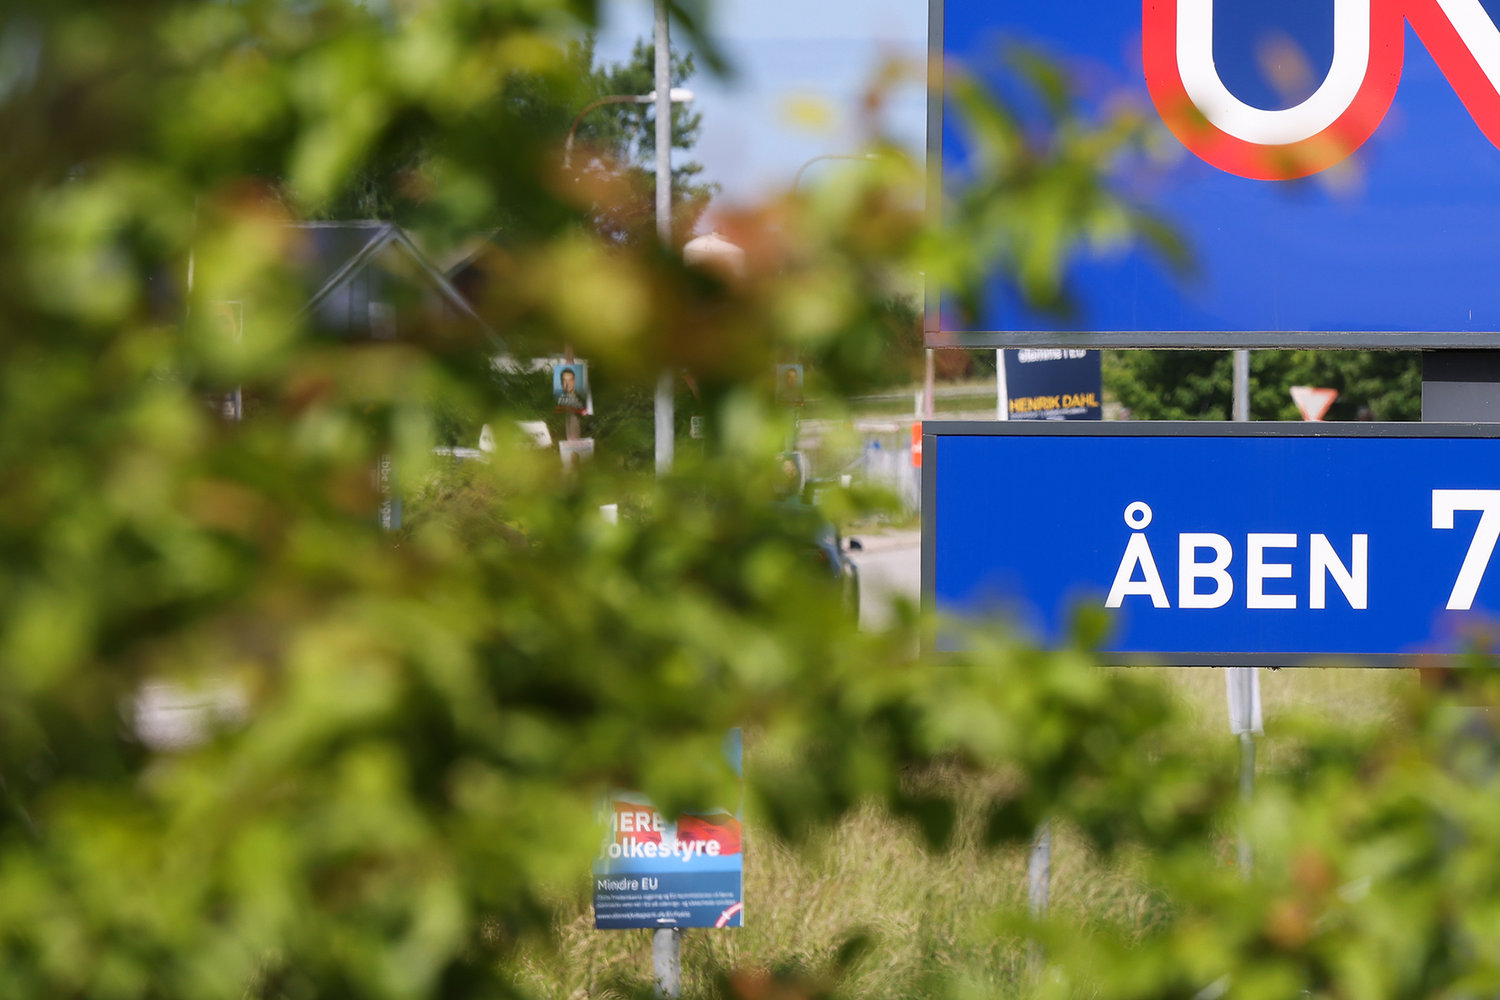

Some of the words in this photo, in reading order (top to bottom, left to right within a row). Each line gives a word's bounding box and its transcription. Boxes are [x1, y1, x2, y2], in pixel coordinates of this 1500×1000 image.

[1009, 395, 1060, 413] HENRIK
[1062, 392, 1098, 407] DAHL
[1105, 501, 1368, 609] ÅBEN
[597, 878, 639, 891] Mindre
[641, 877, 658, 891] EU
